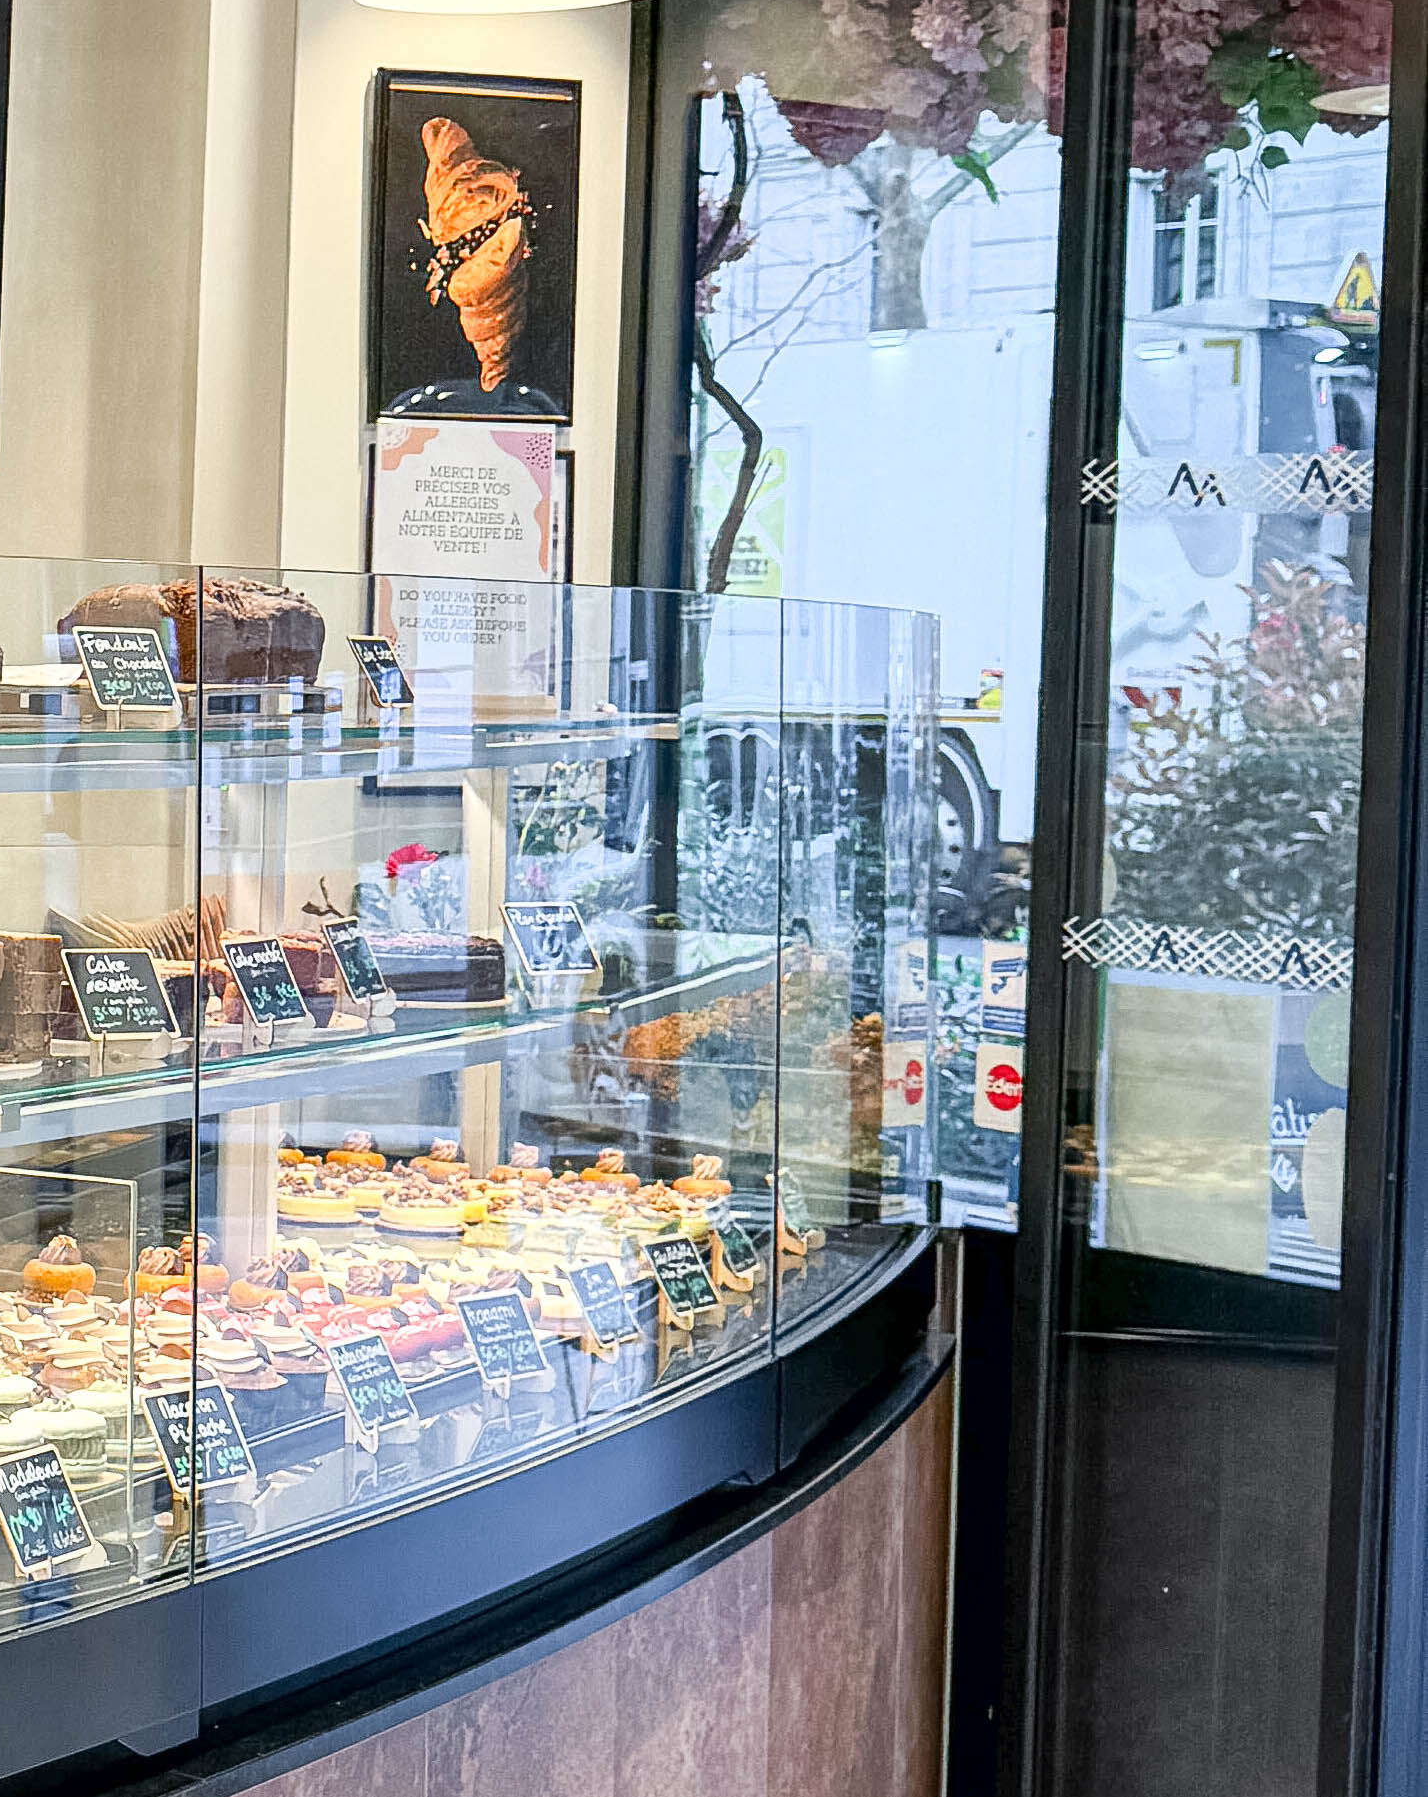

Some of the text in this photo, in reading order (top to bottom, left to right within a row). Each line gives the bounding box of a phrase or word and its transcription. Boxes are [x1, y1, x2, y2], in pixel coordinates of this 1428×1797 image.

[430, 466, 497, 479] MERCI DE
[416, 478, 510, 495] PRÉCISER VOS
[425, 496, 498, 509] ALLERGIES
[403, 510, 520, 525] ALIMENTAIRES À
[399, 524, 523, 540] NOTRE ÉQUIPE DE
[399, 590, 527, 604] DO YOU HAVE FOOD
[399, 617, 448, 629] PLEASE
[476, 619, 526, 632] BEFORE
[80, 634, 151, 653] Fondant
[86, 955, 130, 974] Cake
